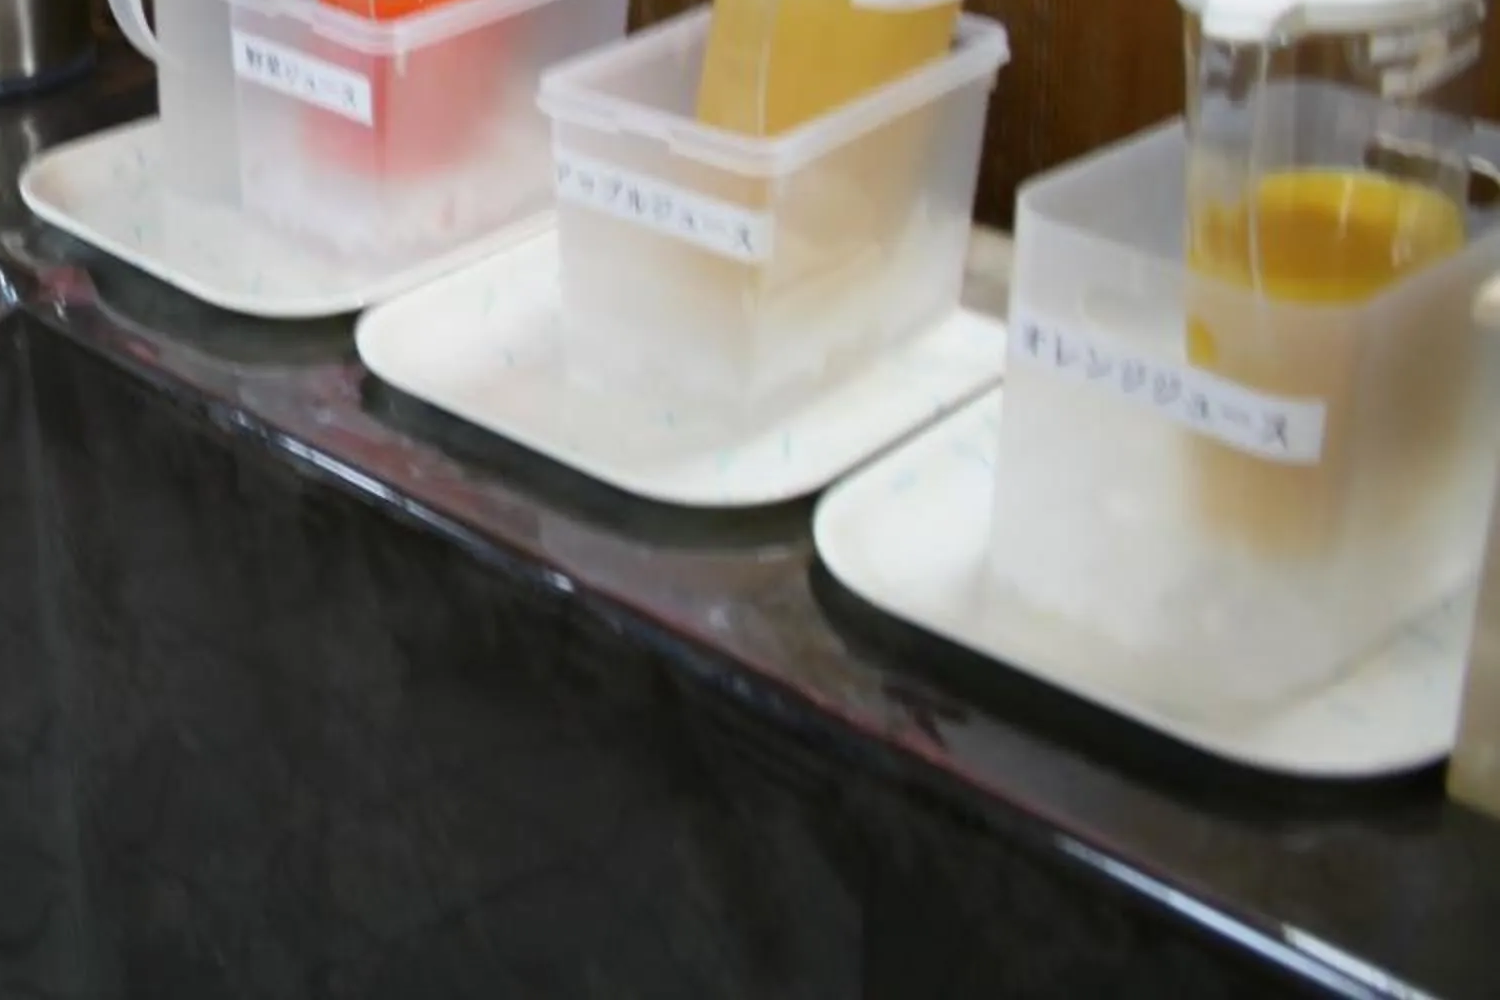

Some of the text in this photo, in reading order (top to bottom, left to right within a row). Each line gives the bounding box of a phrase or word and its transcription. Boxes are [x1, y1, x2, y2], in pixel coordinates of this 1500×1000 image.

[1020, 322, 1290, 452] オレンジジュース
